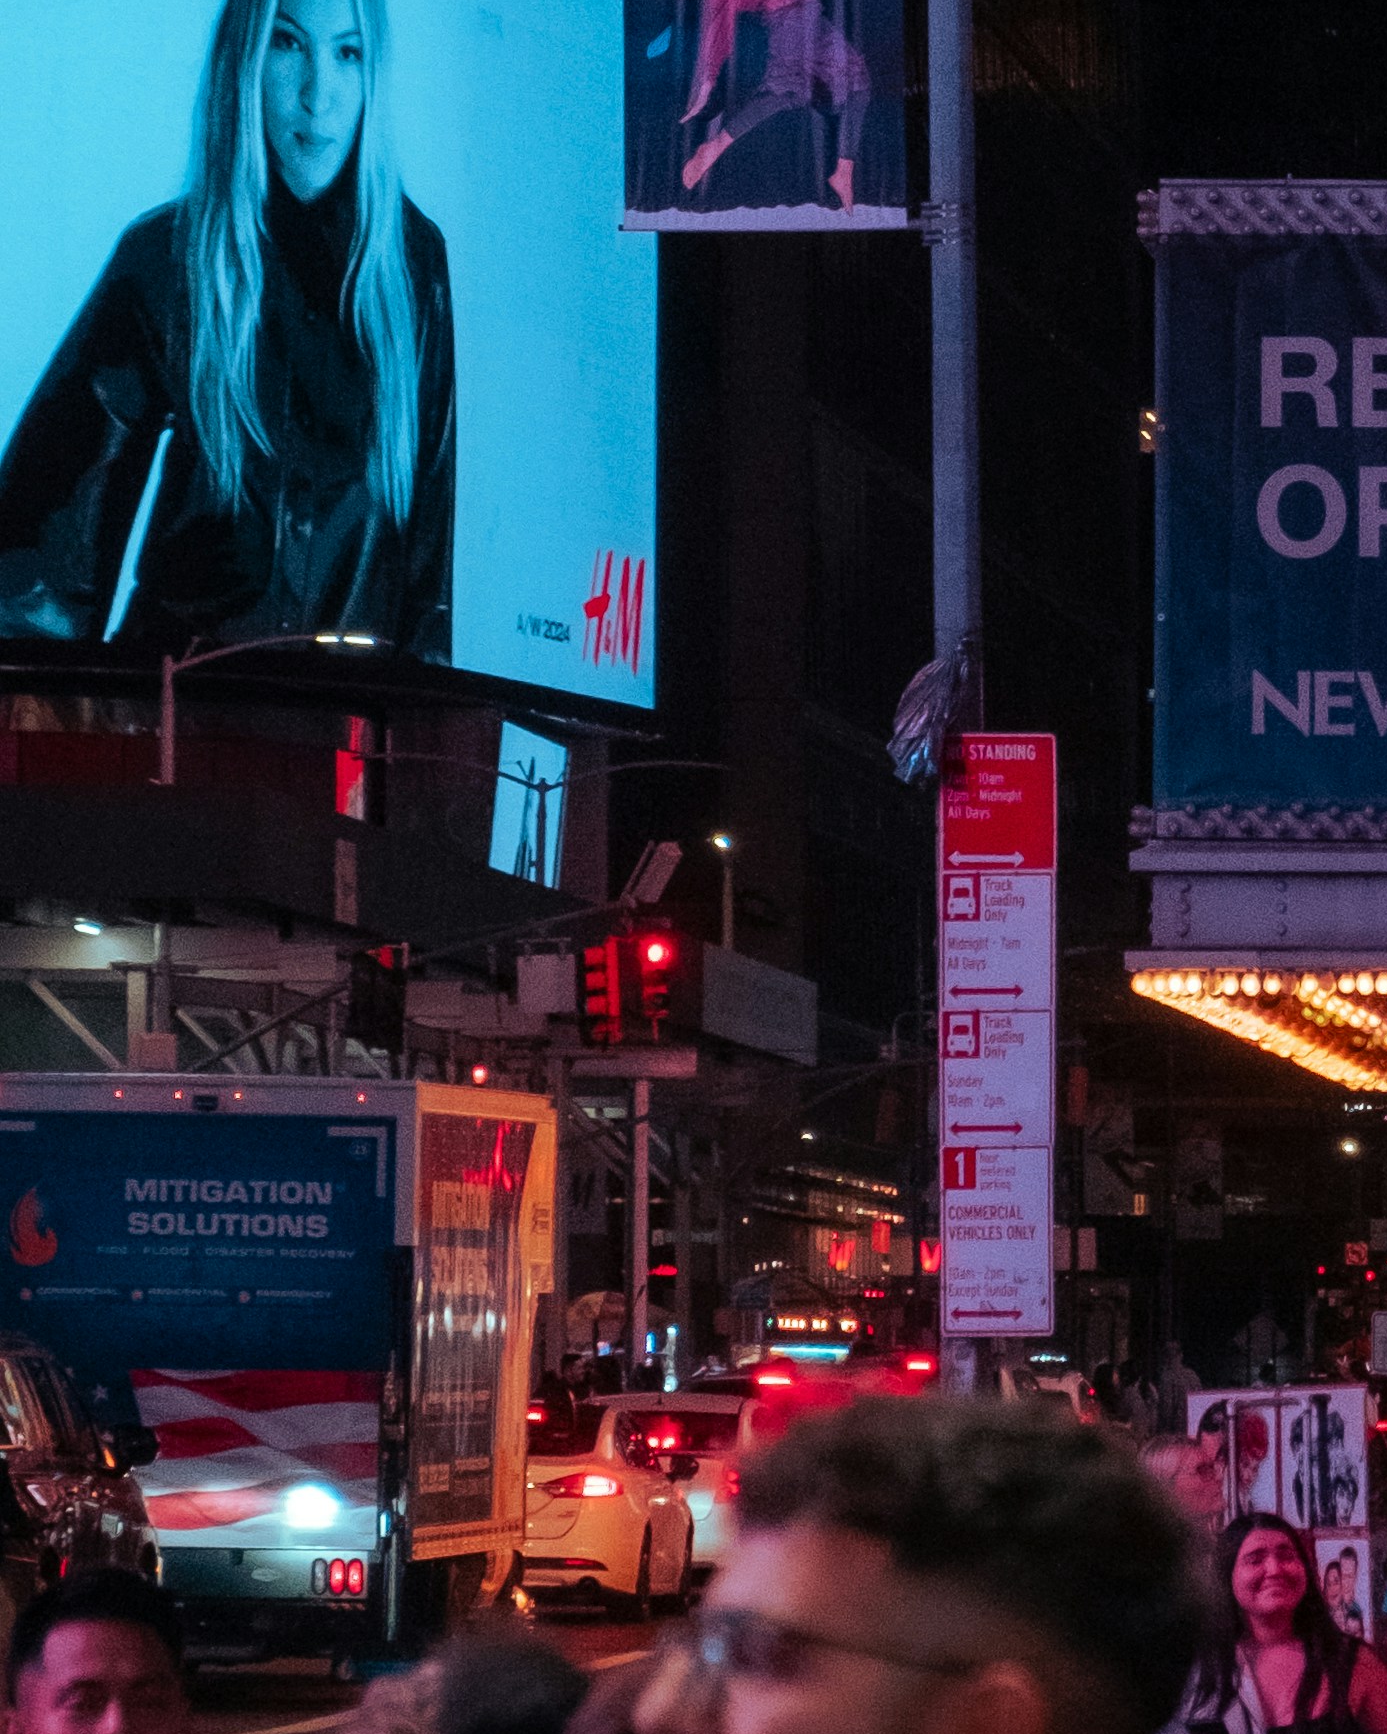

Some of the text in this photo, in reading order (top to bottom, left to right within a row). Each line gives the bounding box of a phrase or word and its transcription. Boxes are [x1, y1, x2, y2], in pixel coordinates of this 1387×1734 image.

[581, 547, 646, 677] H&M
[969, 744, 1037, 761] STANDING
[979, 789, 1023, 804] Midnight
[966, 806, 992, 821] Days
[954, 1151, 966, 1187] 1
[125, 1178, 334, 1205] MITIGATION
[948, 1205, 1025, 1221] COMMERCIAL
[127, 1211, 329, 1238] SOLUTIONS
[948, 1225, 1037, 1241] VEHICLES ONLY
[205, 1246, 275, 1258] DISASTER
[279, 1246, 356, 1260] RECOVERY
